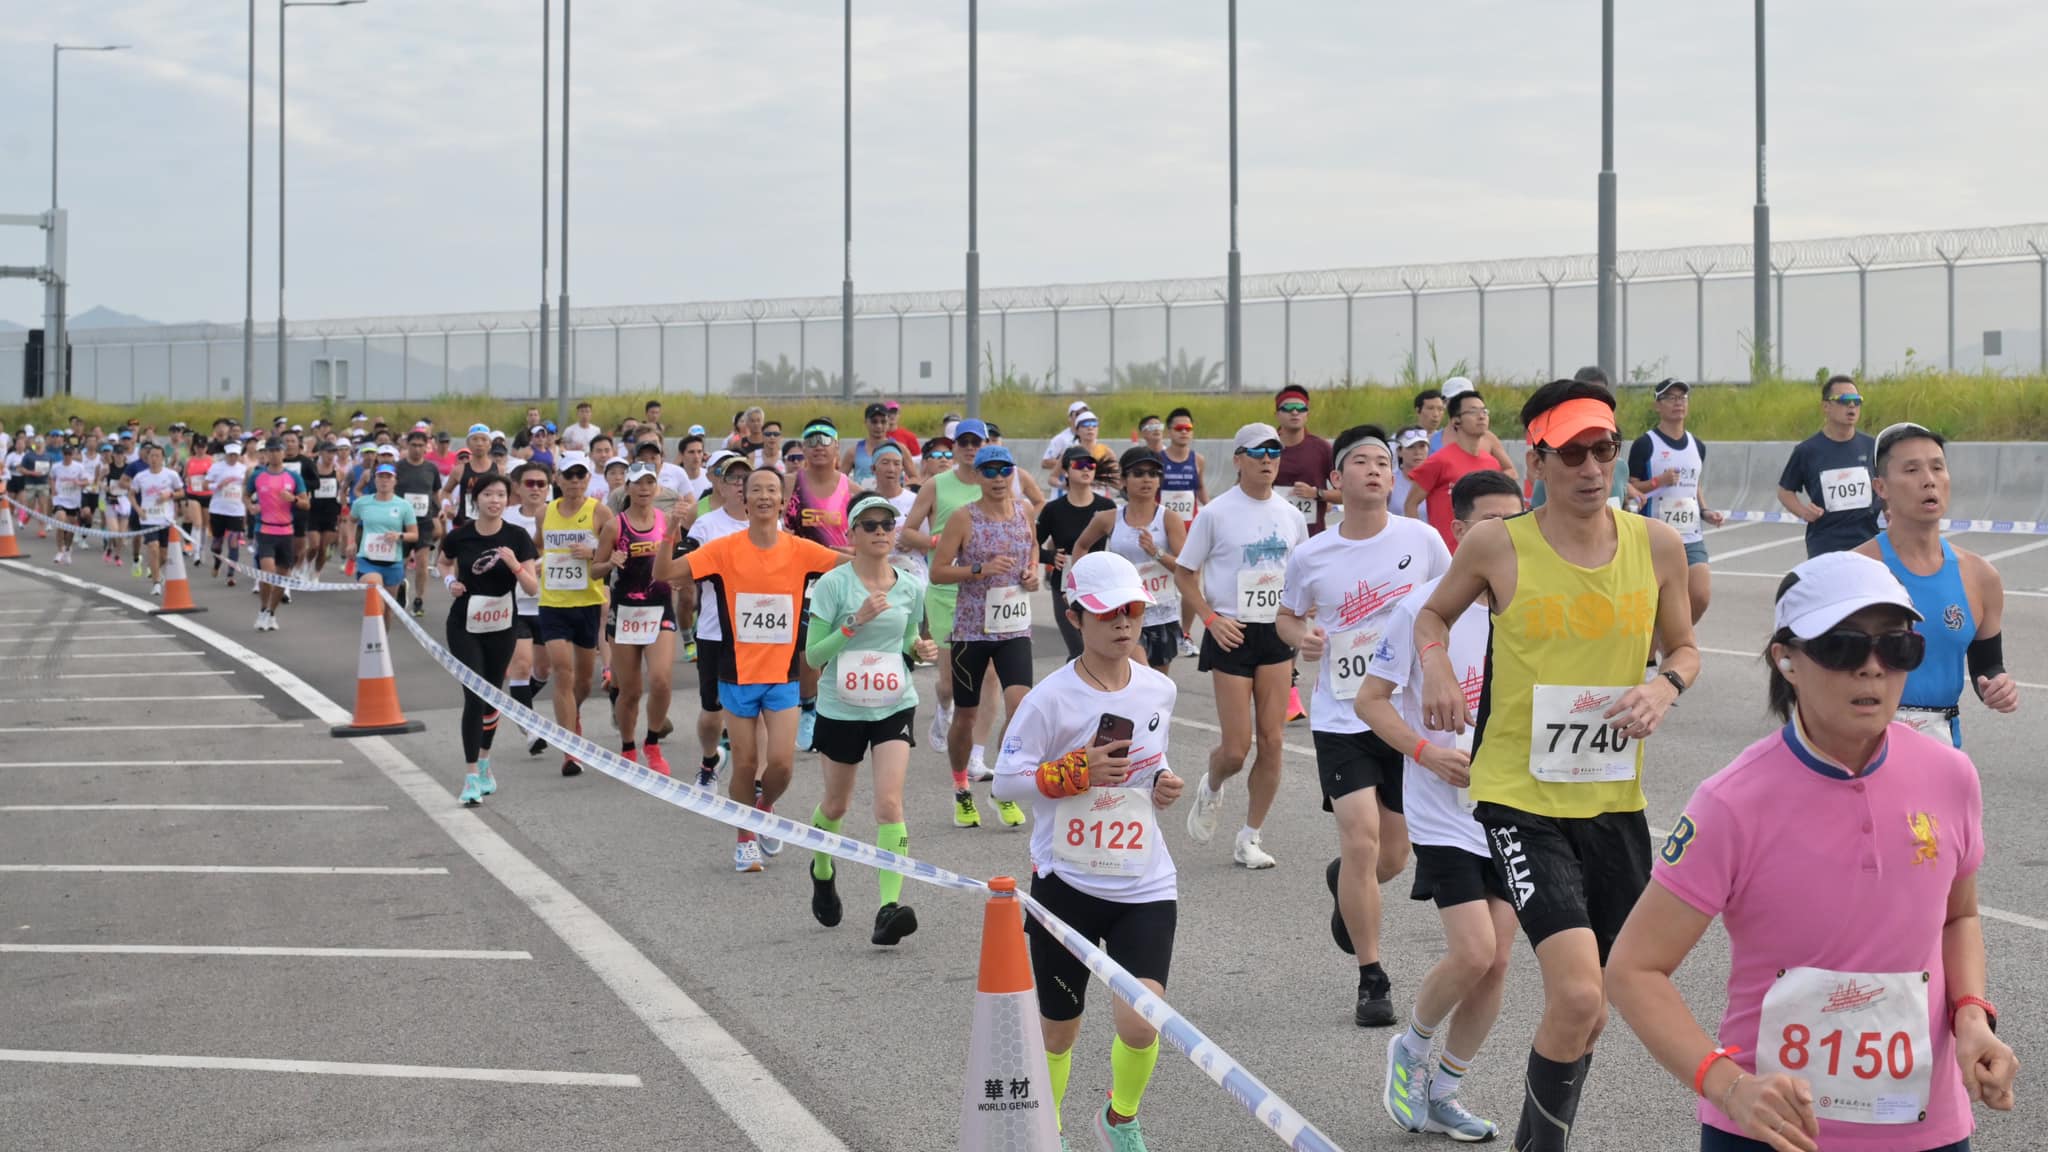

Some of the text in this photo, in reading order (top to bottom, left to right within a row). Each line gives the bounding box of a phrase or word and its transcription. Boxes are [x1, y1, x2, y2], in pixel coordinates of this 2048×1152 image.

[1827, 482, 1866, 500] 7097
[1664, 511, 1694, 524] 7461
[547, 566, 583, 579] 7753
[472, 607, 509, 623] 4004
[991, 601, 1027, 620] 7040
[622, 619, 658, 633] 8017
[741, 612, 788, 629] 7484
[1337, 652, 1374, 680] 30
[845, 671, 899, 691] 8166
[1546, 723, 1630, 754] 7740
[1066, 818, 1144, 850] 8122
[1660, 813, 1696, 866] B
[1778, 1023, 1914, 1080] 8150
[984, 1077, 1031, 1101] 華材
[977, 1100, 1040, 1112] WORLD GENIUS
